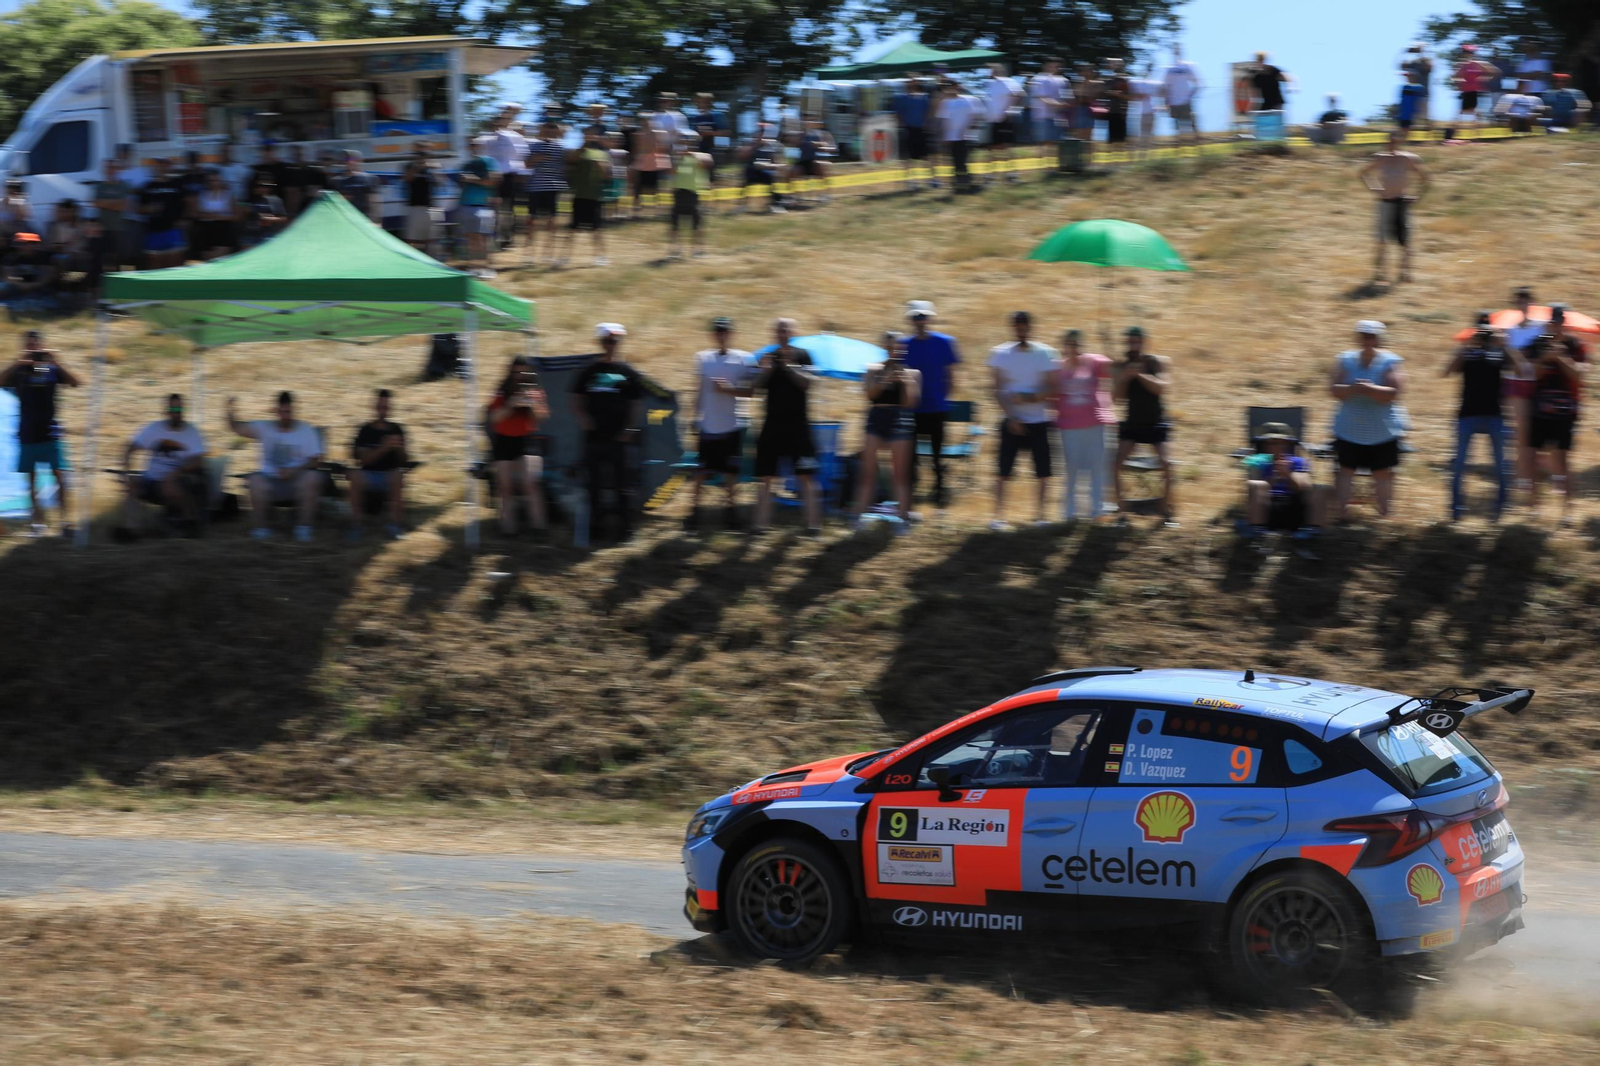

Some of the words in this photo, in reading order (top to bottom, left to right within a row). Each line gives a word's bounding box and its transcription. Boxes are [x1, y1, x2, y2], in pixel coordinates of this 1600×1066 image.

[1195, 697, 1245, 711] Rallycar
[1127, 743, 1137, 758] P.
[1140, 744, 1173, 761] Lopez
[1124, 761, 1136, 776] D.
[1140, 762, 1186, 780] Vazquez
[1229, 746, 1253, 782] 9
[885, 774, 912, 785] i20
[753, 788, 799, 800] HYUNDAI
[889, 812, 908, 838] 9
[921, 817, 944, 831] La
[899, 848, 932, 859] Recalvi
[1041, 846, 1196, 889] cetelem
[932, 910, 1023, 931] HYUNDAI
